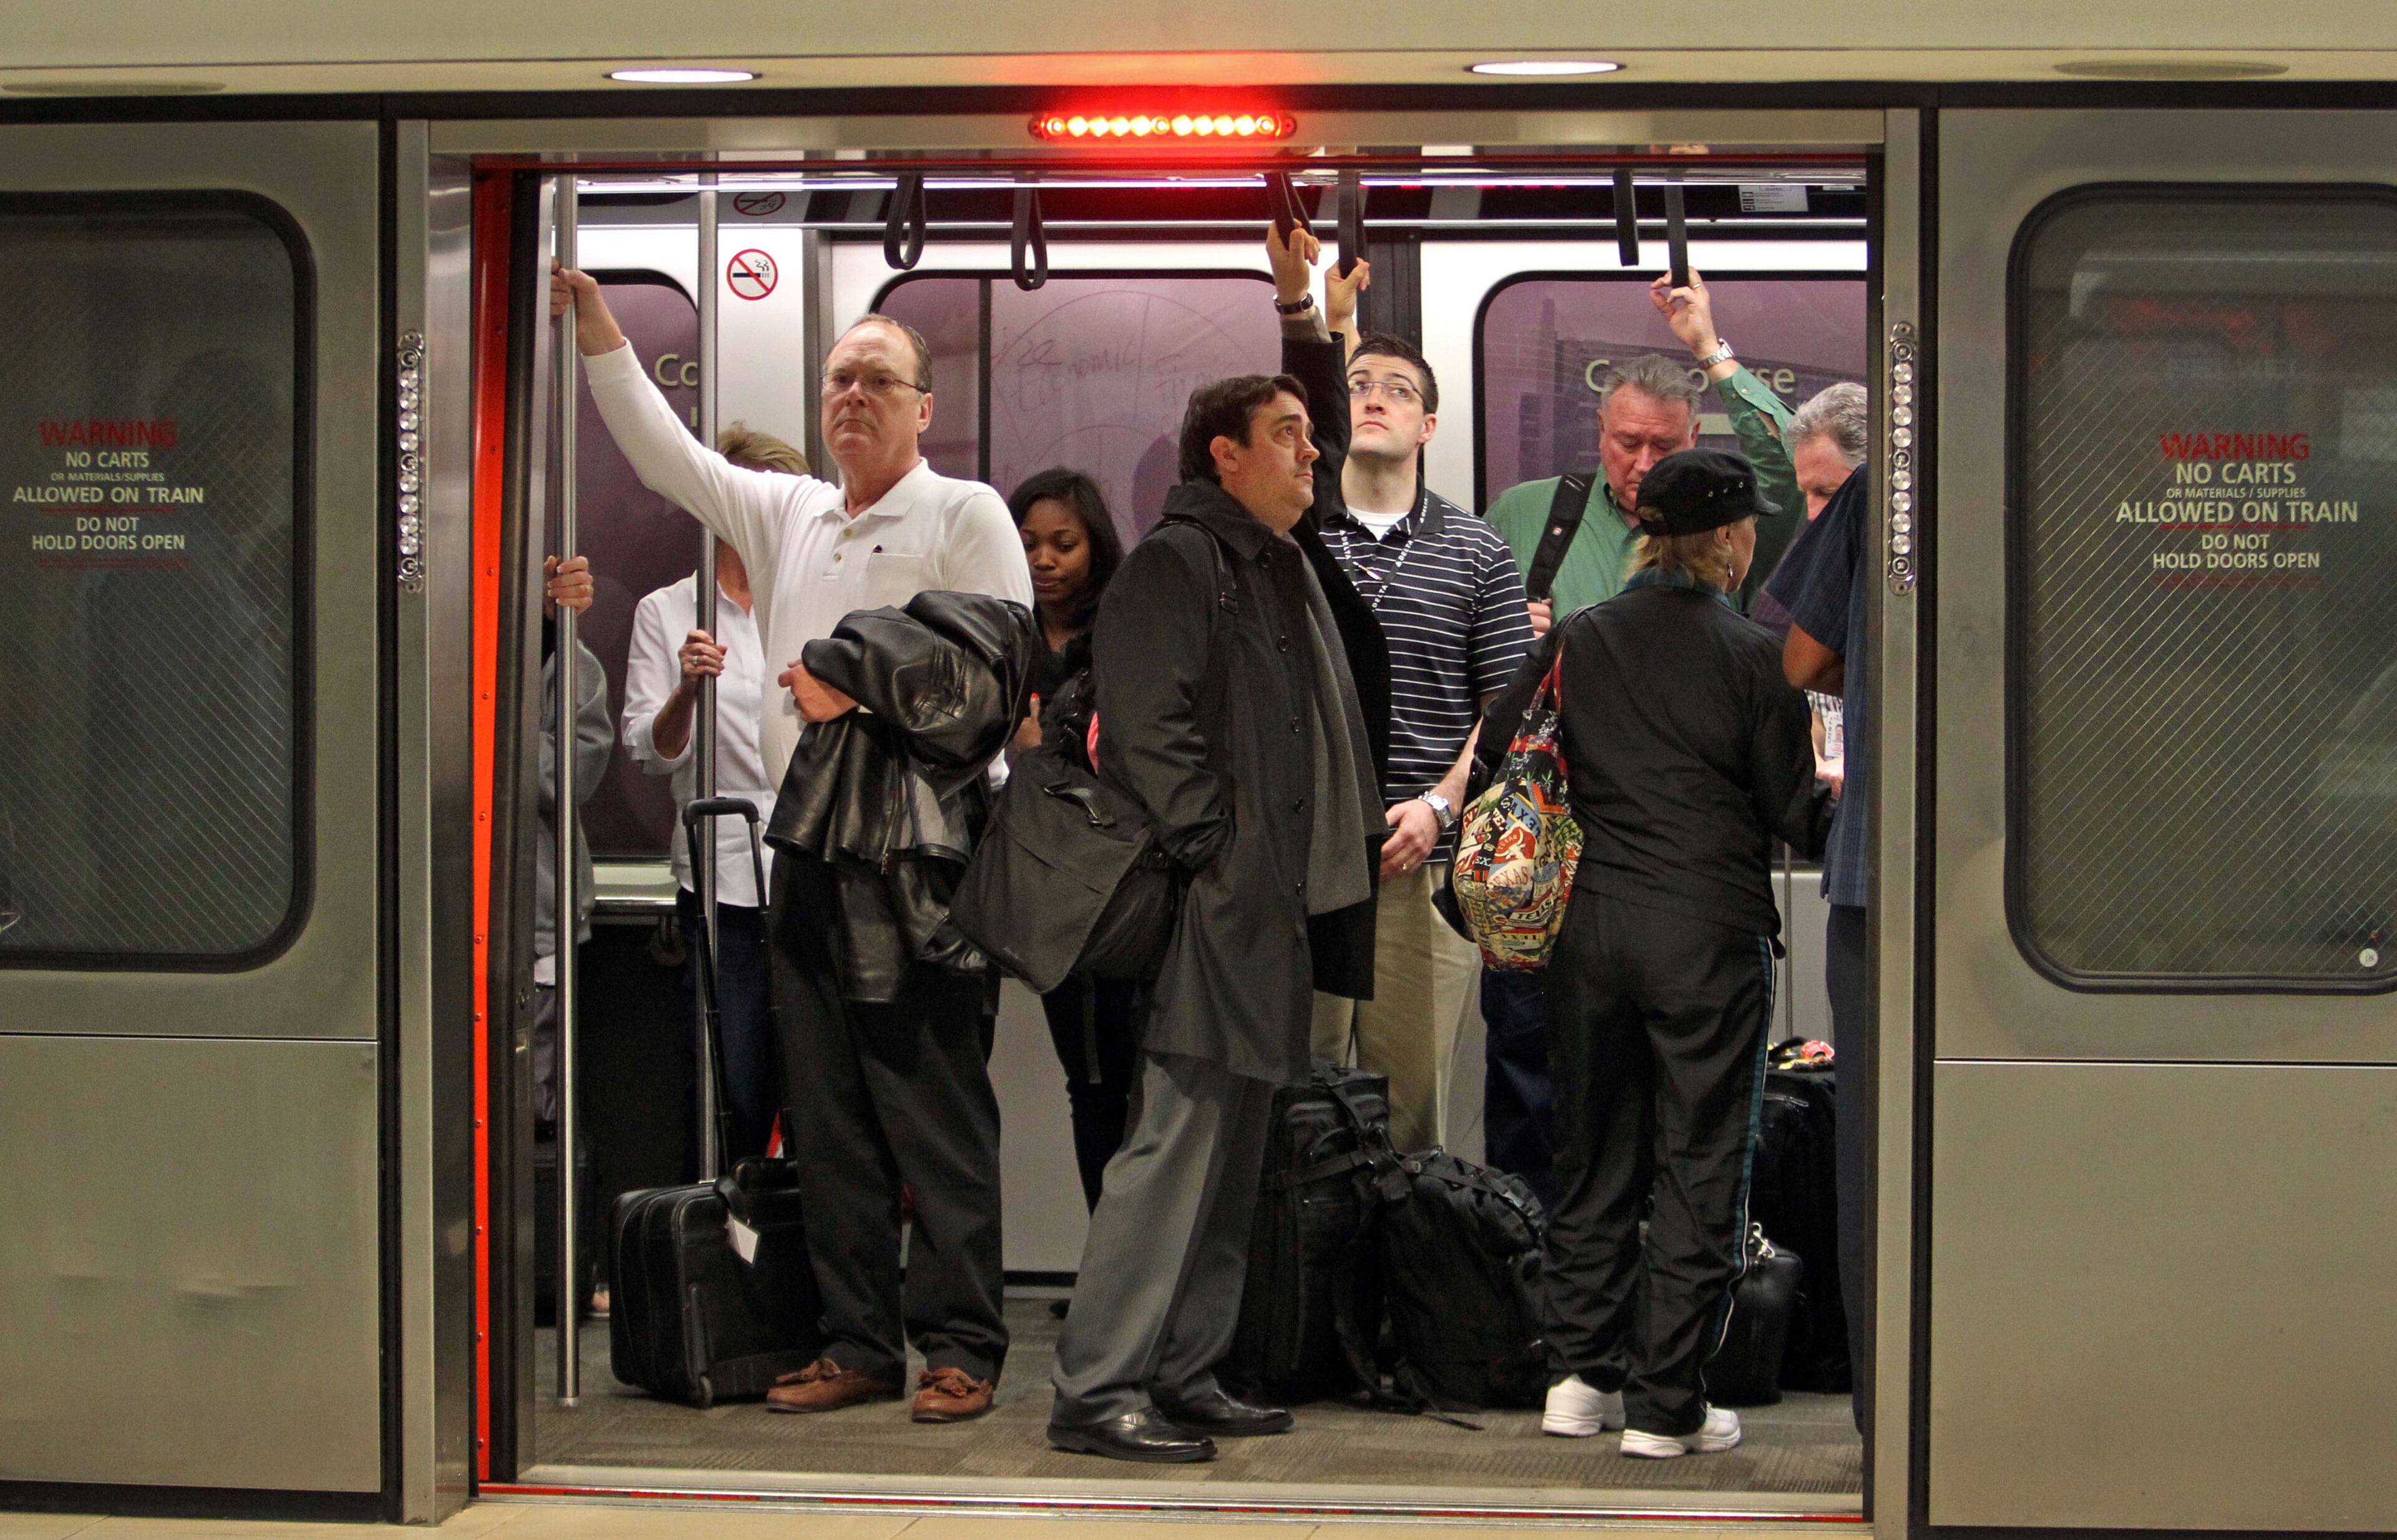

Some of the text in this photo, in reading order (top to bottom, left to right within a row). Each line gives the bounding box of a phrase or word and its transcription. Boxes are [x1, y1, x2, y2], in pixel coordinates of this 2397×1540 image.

[39, 419, 177, 448] WARNING
[2160, 433, 2309, 461] WARNING
[66, 452, 149, 468] NO CARTS
[51, 473, 64, 481] OR
[2175, 462, 2297, 484] NO CARTS
[12, 487, 204, 503] ALLOWED ON TRAIN
[2166, 488, 2182, 499] OR
[2185, 487, 2246, 499] MATERIALS
[2257, 487, 2306, 499] SUPPLIES
[2115, 501, 2358, 523] ALLOWED ON TRAIN
[76, 517, 140, 531] DO NOT
[32, 535, 185, 550] HOLD DOORS OPEN
[1341, 536, 1351, 559] DELTA
[2202, 534, 2270, 549] DO NOT
[1398, 540, 1414, 561] DELTA
[2152, 552, 2320, 569] HOLD DOORS OPEN
[1371, 584, 1389, 609] DELTA
